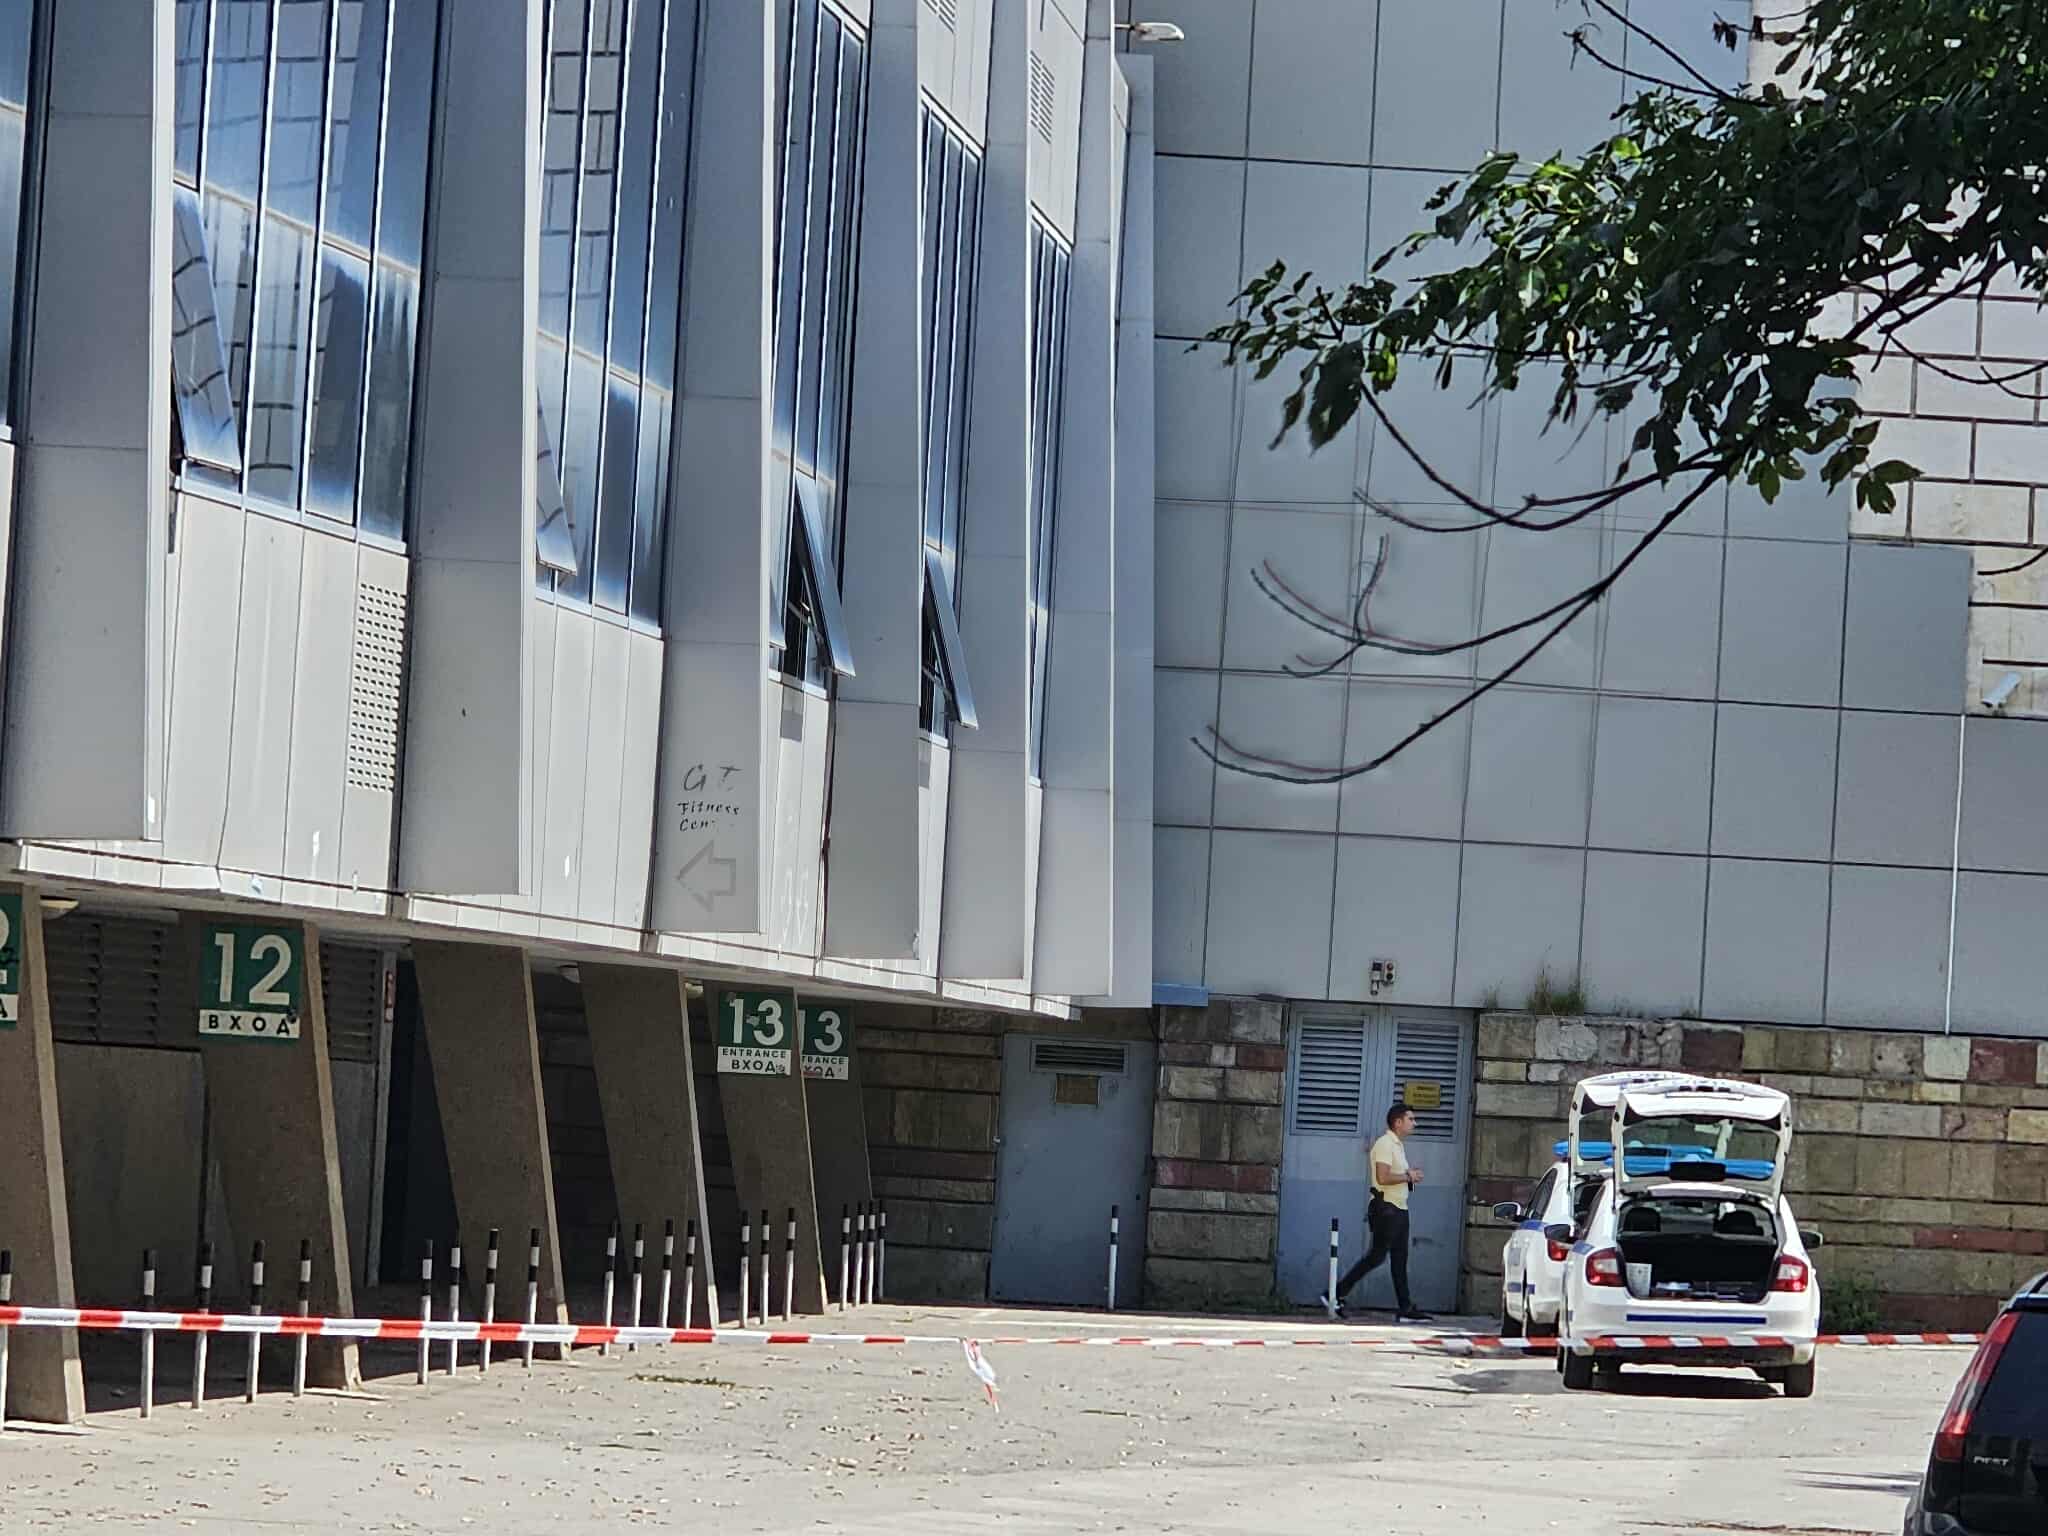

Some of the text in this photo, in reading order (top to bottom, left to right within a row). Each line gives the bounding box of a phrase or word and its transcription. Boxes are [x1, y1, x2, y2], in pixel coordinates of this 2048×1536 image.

[215, 932, 292, 1006] 12
[208, 1014, 291, 1036] ВХОД
[729, 998, 785, 1046] 13
[722, 1047, 787, 1059] ENTRANCE
[801, 1055, 846, 1065] TRANCE
